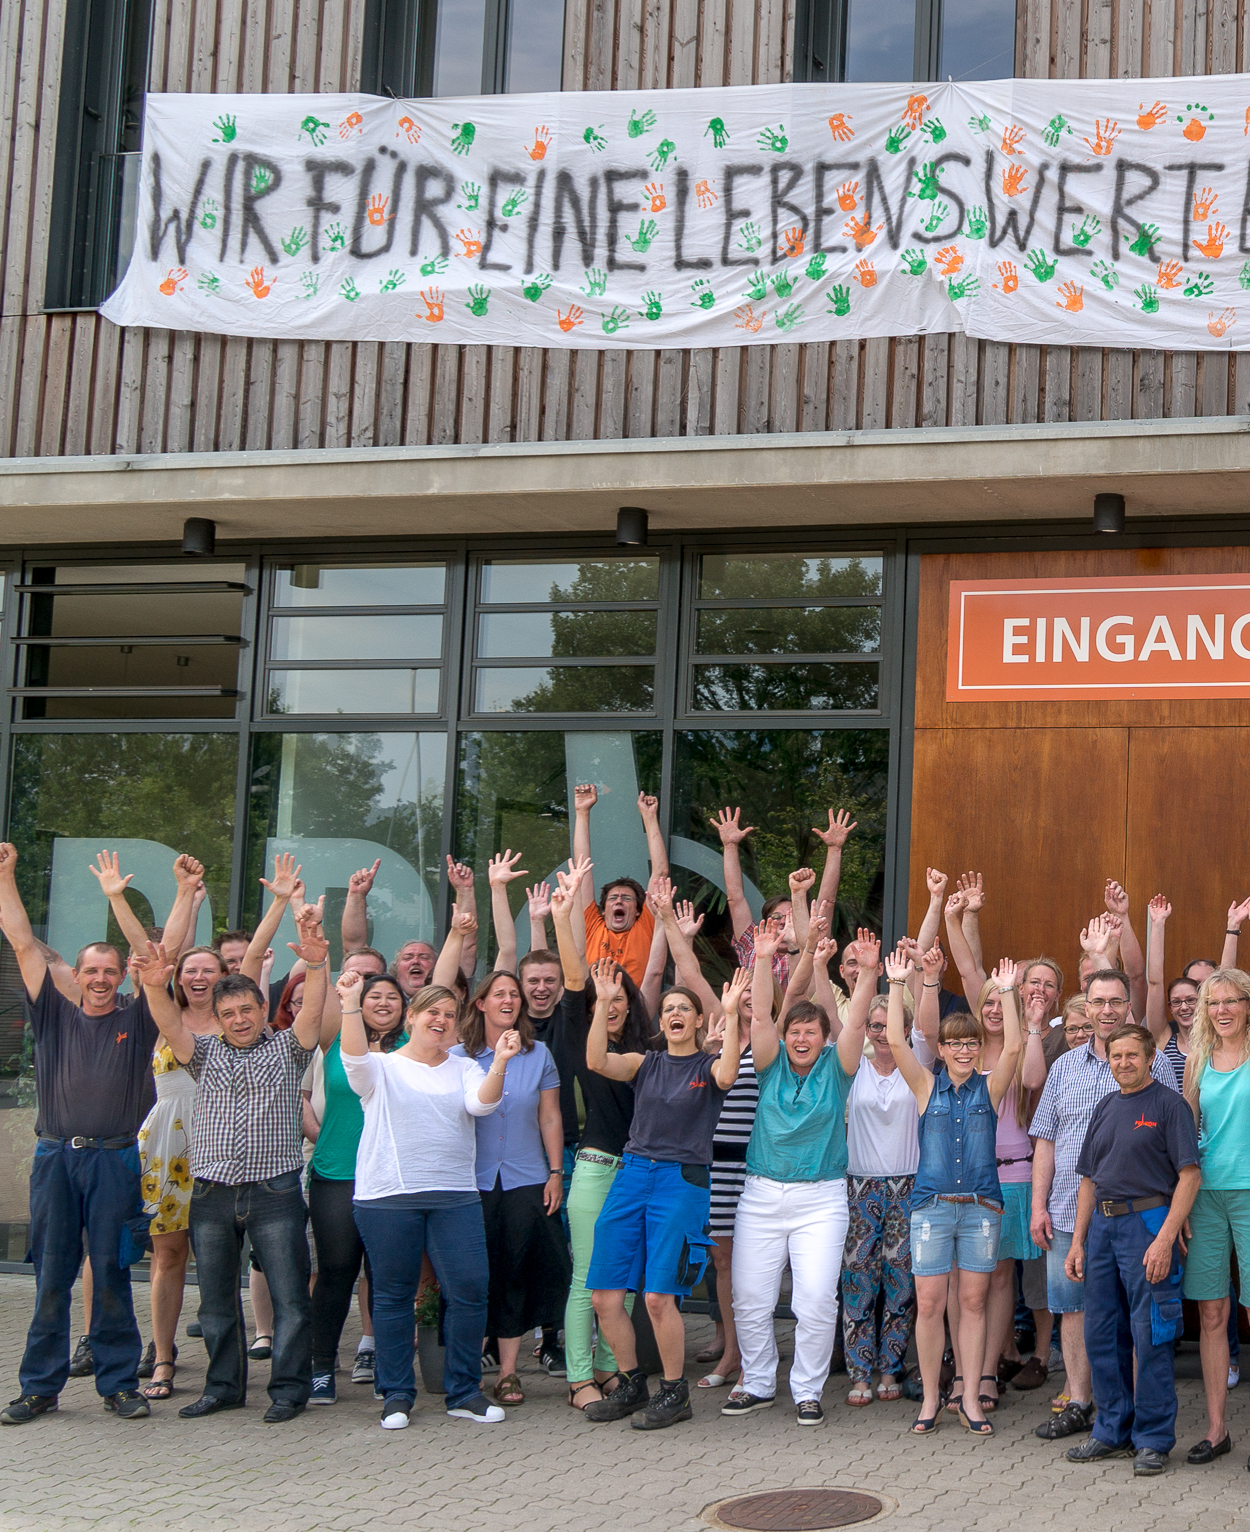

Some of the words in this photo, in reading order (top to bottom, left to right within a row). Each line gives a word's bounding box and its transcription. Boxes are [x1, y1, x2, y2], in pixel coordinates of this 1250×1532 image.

[149, 149, 282, 265] WIR
[304, 145, 454, 261] FÜR
[479, 165, 657, 273] EINE
